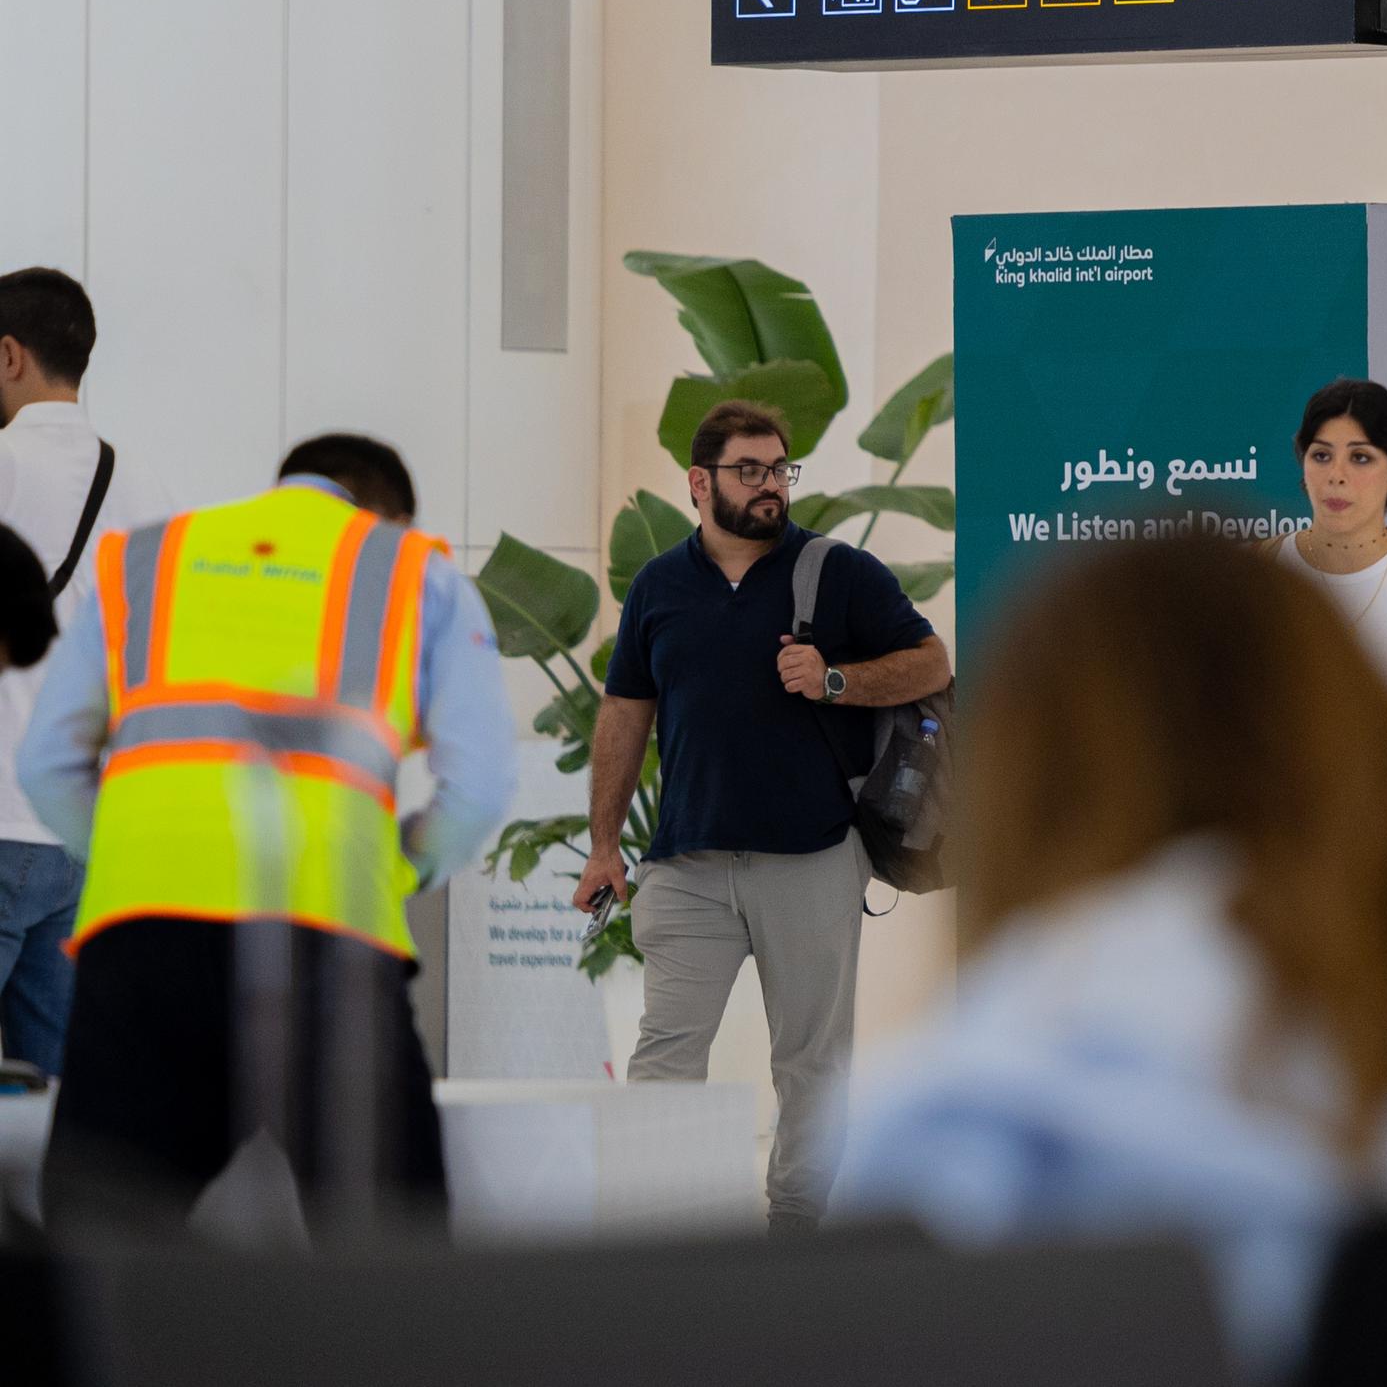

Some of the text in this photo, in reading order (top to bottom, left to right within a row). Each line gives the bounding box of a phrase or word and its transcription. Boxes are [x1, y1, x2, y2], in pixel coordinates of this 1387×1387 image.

[996, 245, 1153, 269] مطار الملك خالد الدولي
[995, 266, 1153, 288] king khalid int'l airport
[1061, 446, 1256, 495] نسمع ونطور
[1009, 510, 1312, 541] We Listen and Develop
[506, 926, 548, 944] develop
[549, 927, 564, 941] for
[488, 953, 572, 968] travel experience
